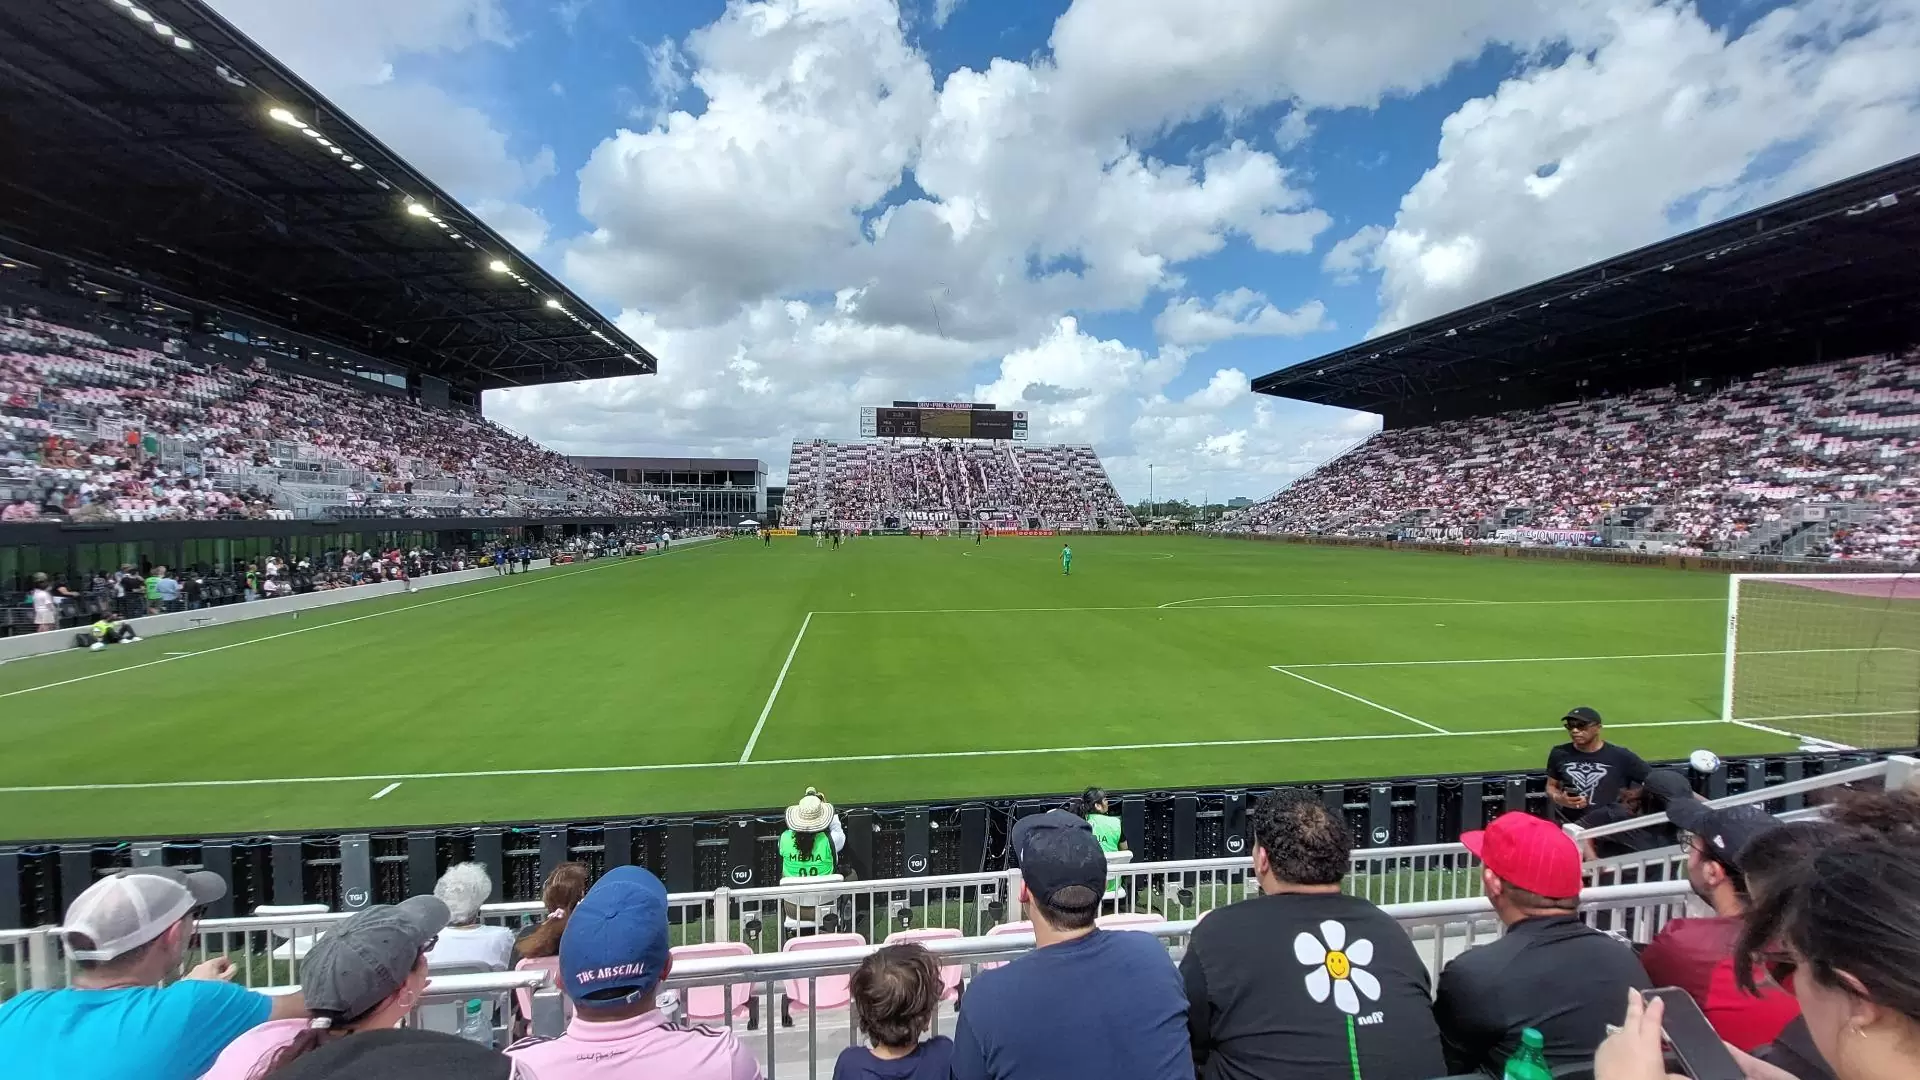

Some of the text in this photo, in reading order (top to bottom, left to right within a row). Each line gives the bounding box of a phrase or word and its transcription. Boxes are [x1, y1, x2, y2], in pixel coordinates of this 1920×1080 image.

[735, 871, 748, 879] TGI
[576, 961, 645, 985] THE ARSENAL
[1357, 1011, 1384, 1026] neff
